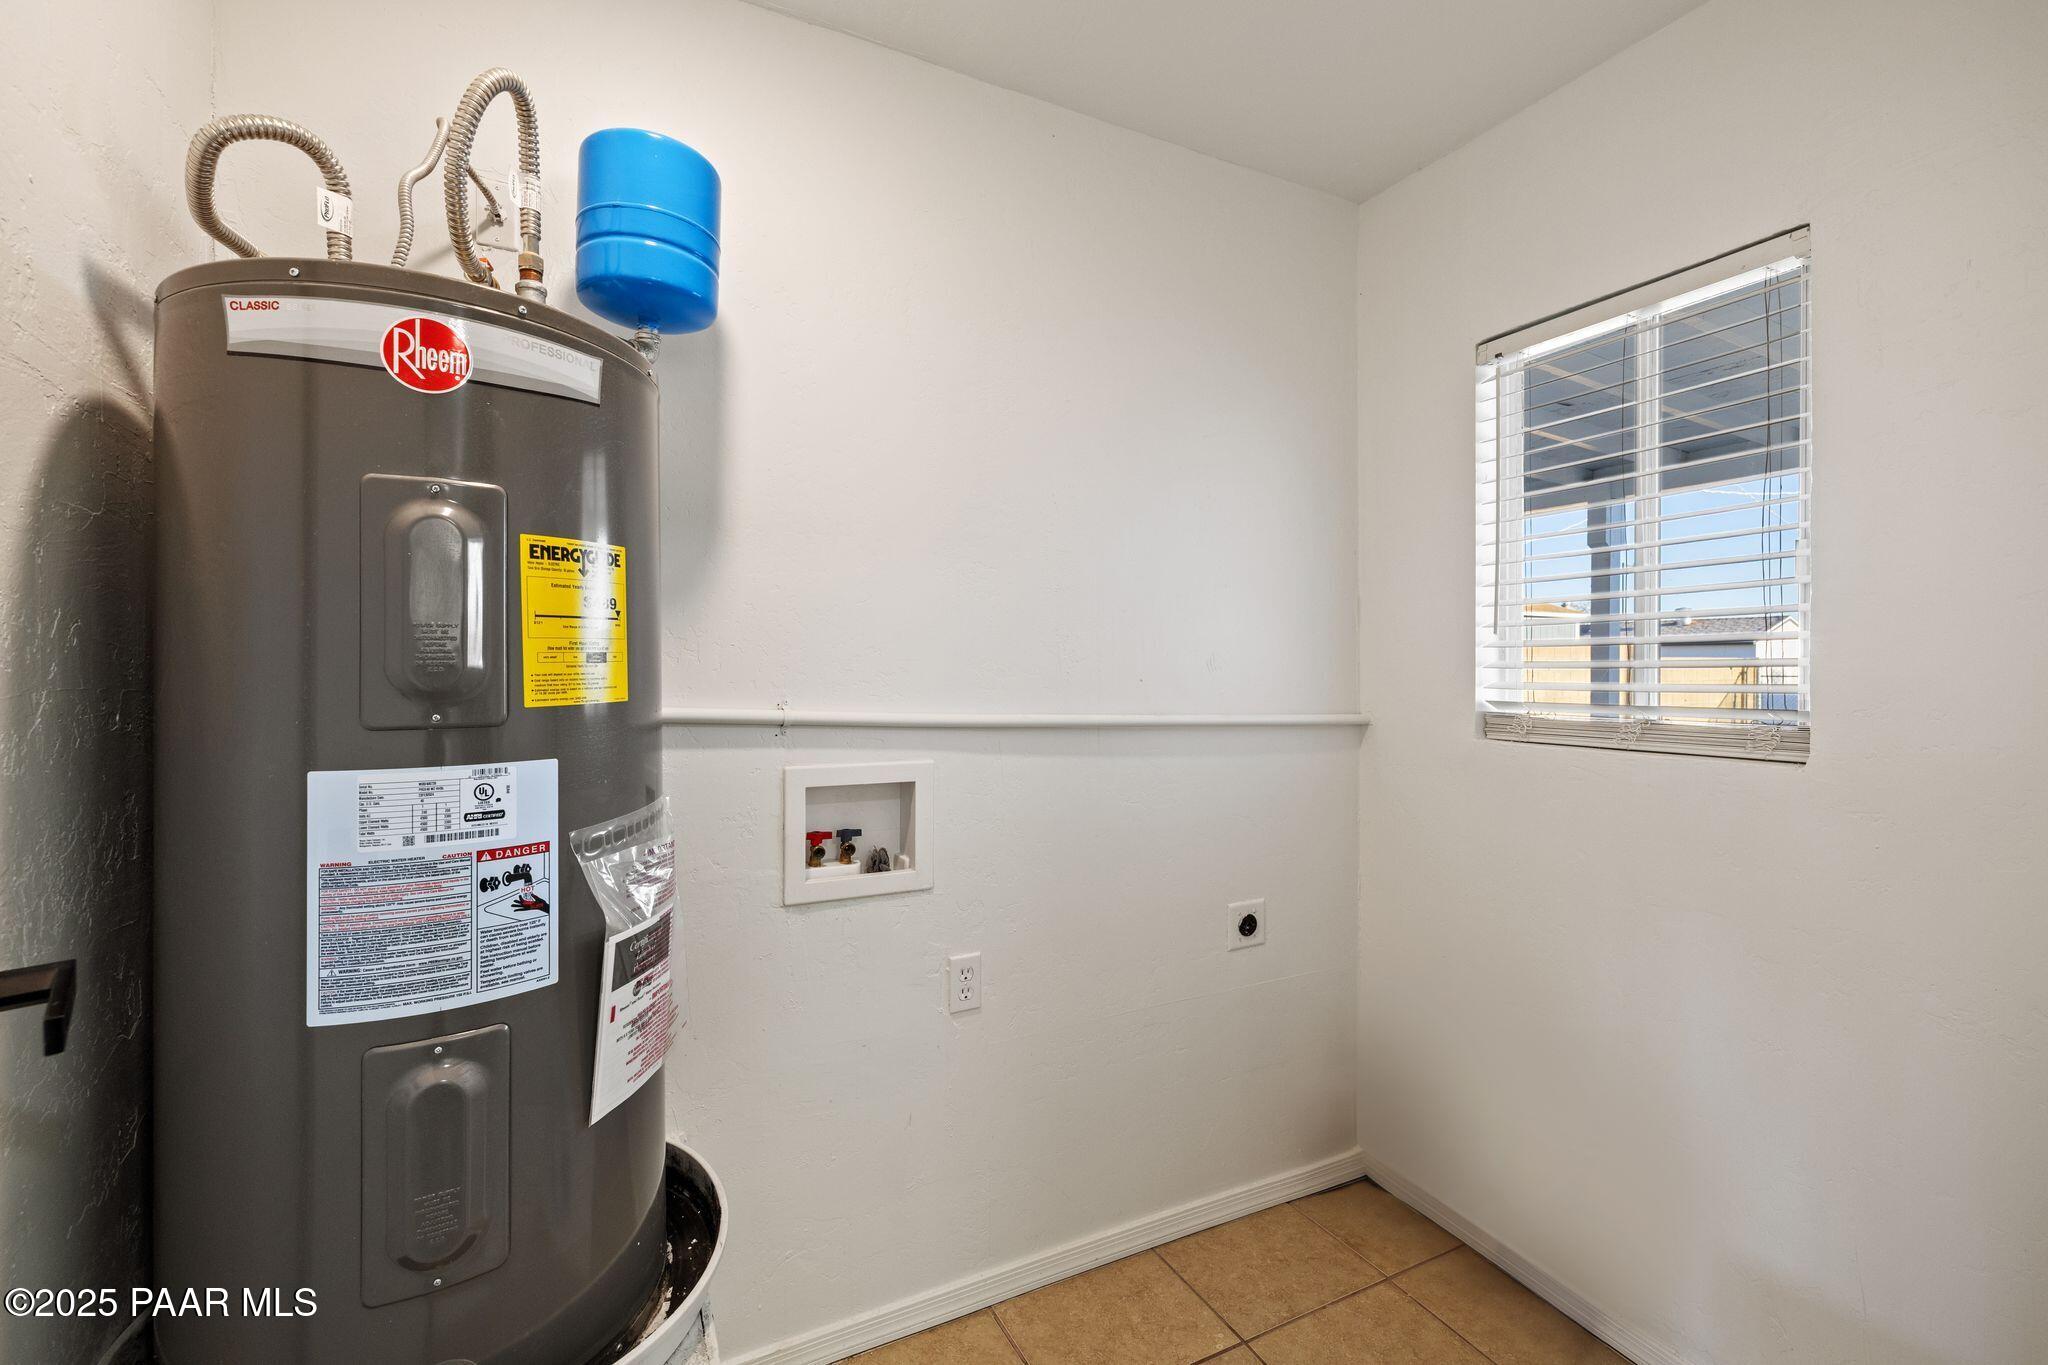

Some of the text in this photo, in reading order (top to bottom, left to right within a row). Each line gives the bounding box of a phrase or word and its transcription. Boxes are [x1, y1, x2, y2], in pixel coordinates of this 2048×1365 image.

[230, 300, 280, 310] CLASSIC
[393, 319, 467, 380] Rheem
[530, 544, 620, 568] ENERGYGDE
[479, 787, 489, 796] UL
[496, 844, 546, 858] DANGER
